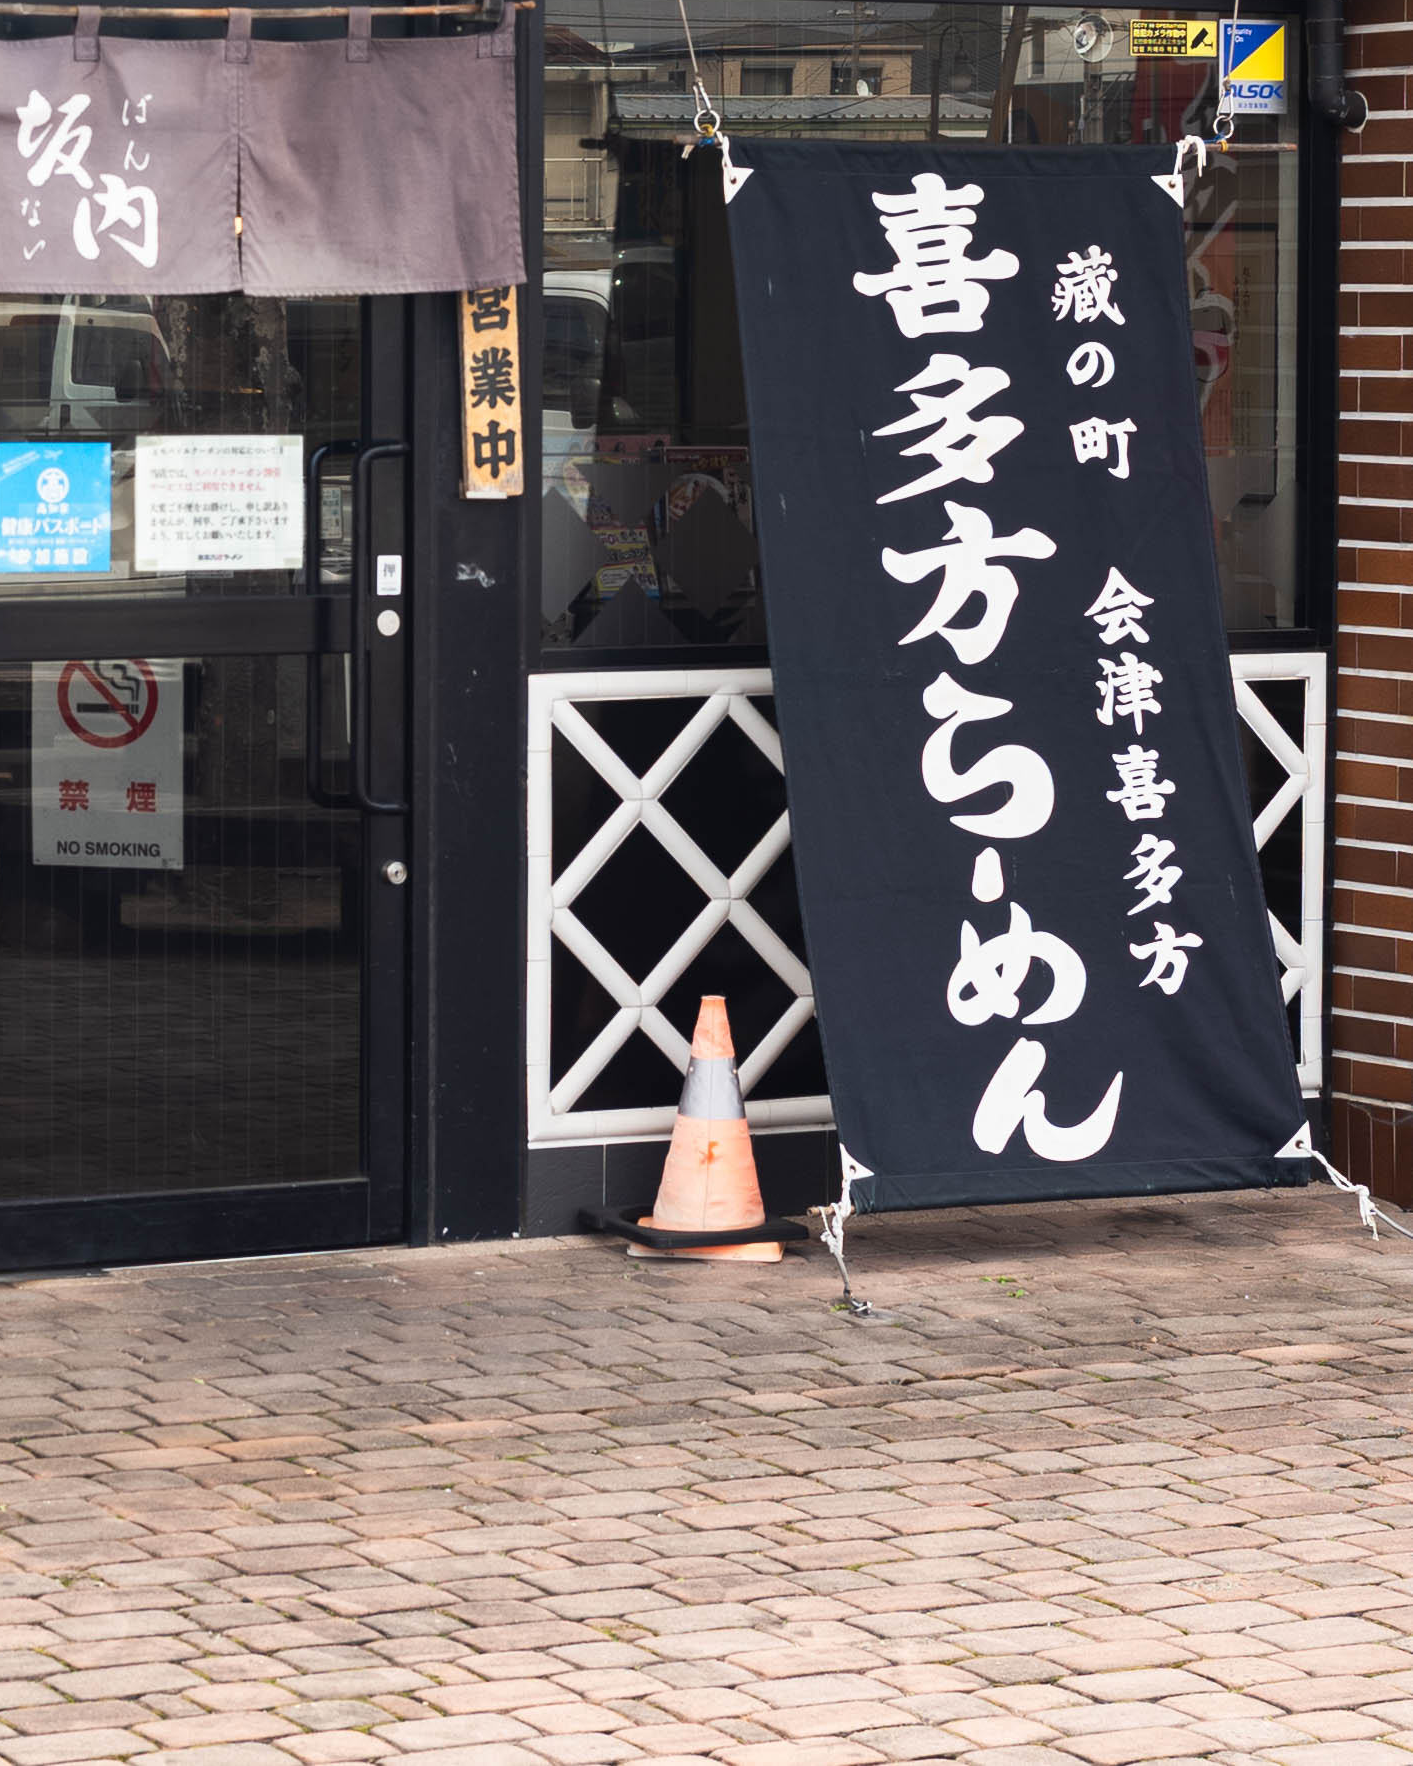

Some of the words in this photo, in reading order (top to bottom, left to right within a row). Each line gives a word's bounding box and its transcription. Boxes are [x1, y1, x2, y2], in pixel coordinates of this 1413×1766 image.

[16, 89, 159, 268] 坂内
[853, 172, 1125, 1162] 喜多方らーめん
[1083, 566, 1204, 995] 会津喜多方
[57, 840, 80, 855] NO
[85, 840, 161, 857] SMOKING
